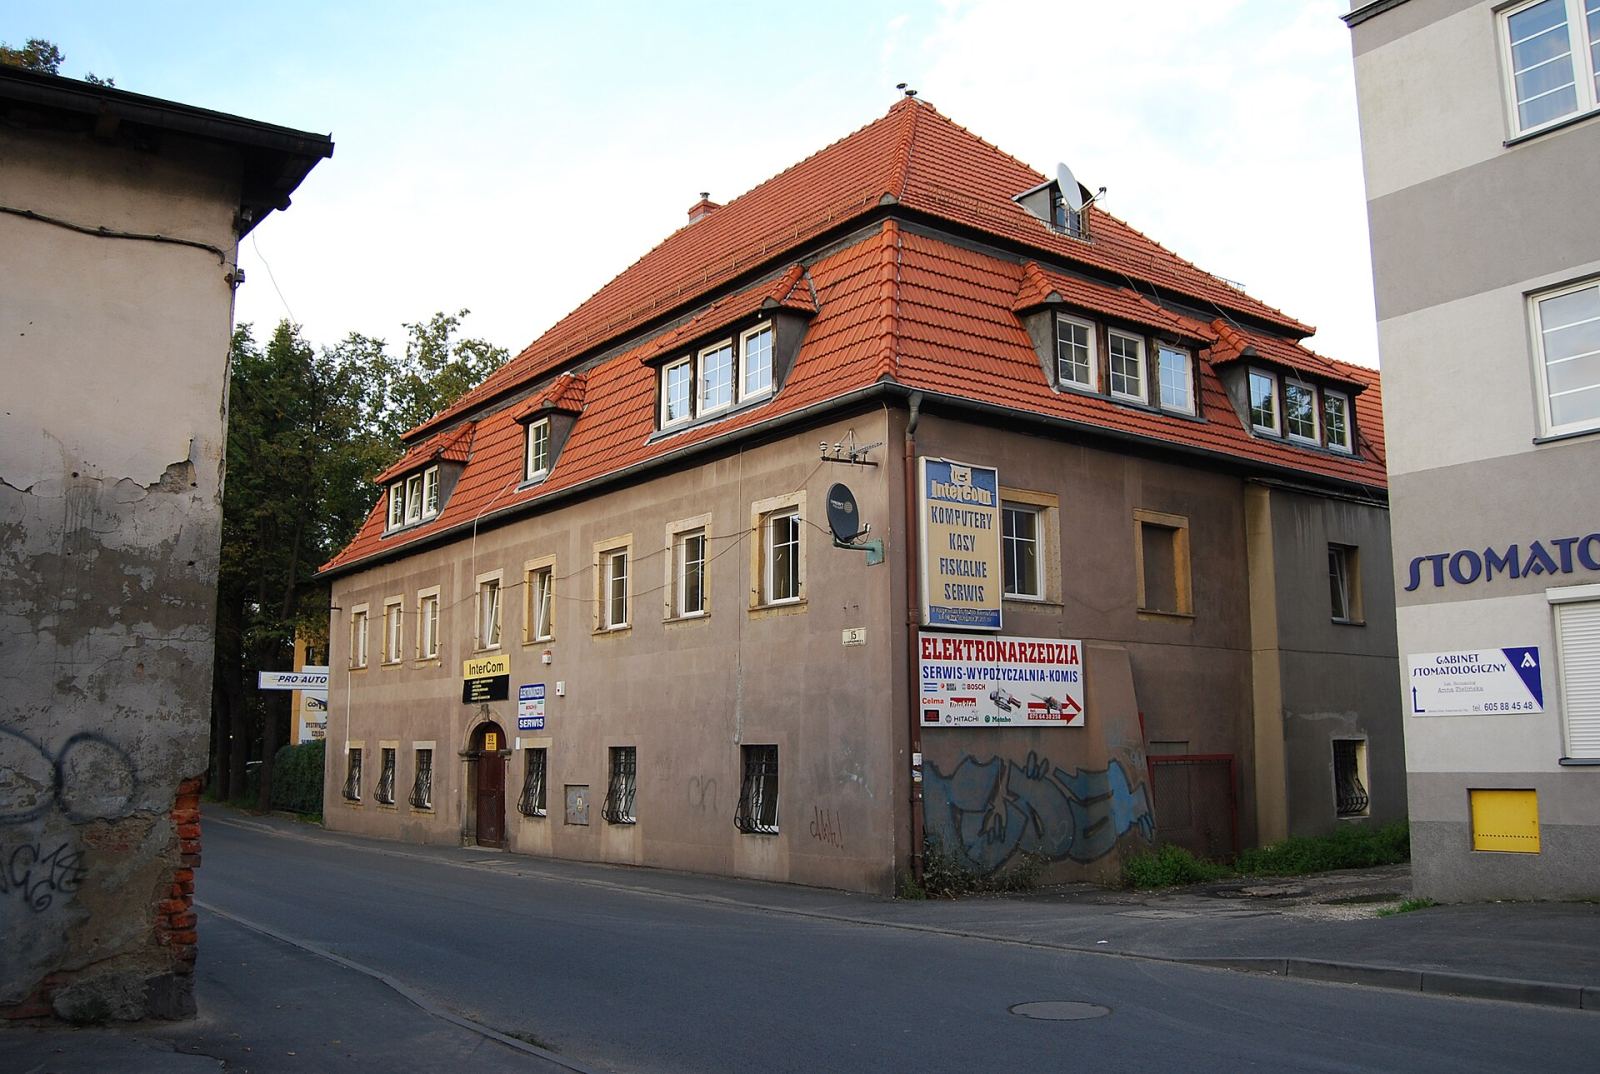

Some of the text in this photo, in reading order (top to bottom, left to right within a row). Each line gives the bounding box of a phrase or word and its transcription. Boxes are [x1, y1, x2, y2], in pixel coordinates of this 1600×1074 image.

[931, 505, 992, 530] KOMPUTERY
[949, 533, 976, 552] KASY
[939, 557, 987, 578] FISKALNE
[944, 583, 984, 602] SERWIS
[1436, 653, 1479, 665] GABINET
[468, 661, 504, 675] InterCom
[1412, 663, 1507, 677] STOMATOLOGICZNY
[301, 676, 327, 684] AUTO
[922, 697, 945, 705] Celma
[1484, 703, 1498, 711] 605
[1500, 703, 1509, 711] 88
[1511, 702, 1521, 710] 45
[1523, 701, 1533, 710] 48
[519, 718, 544, 728] SERWIS
